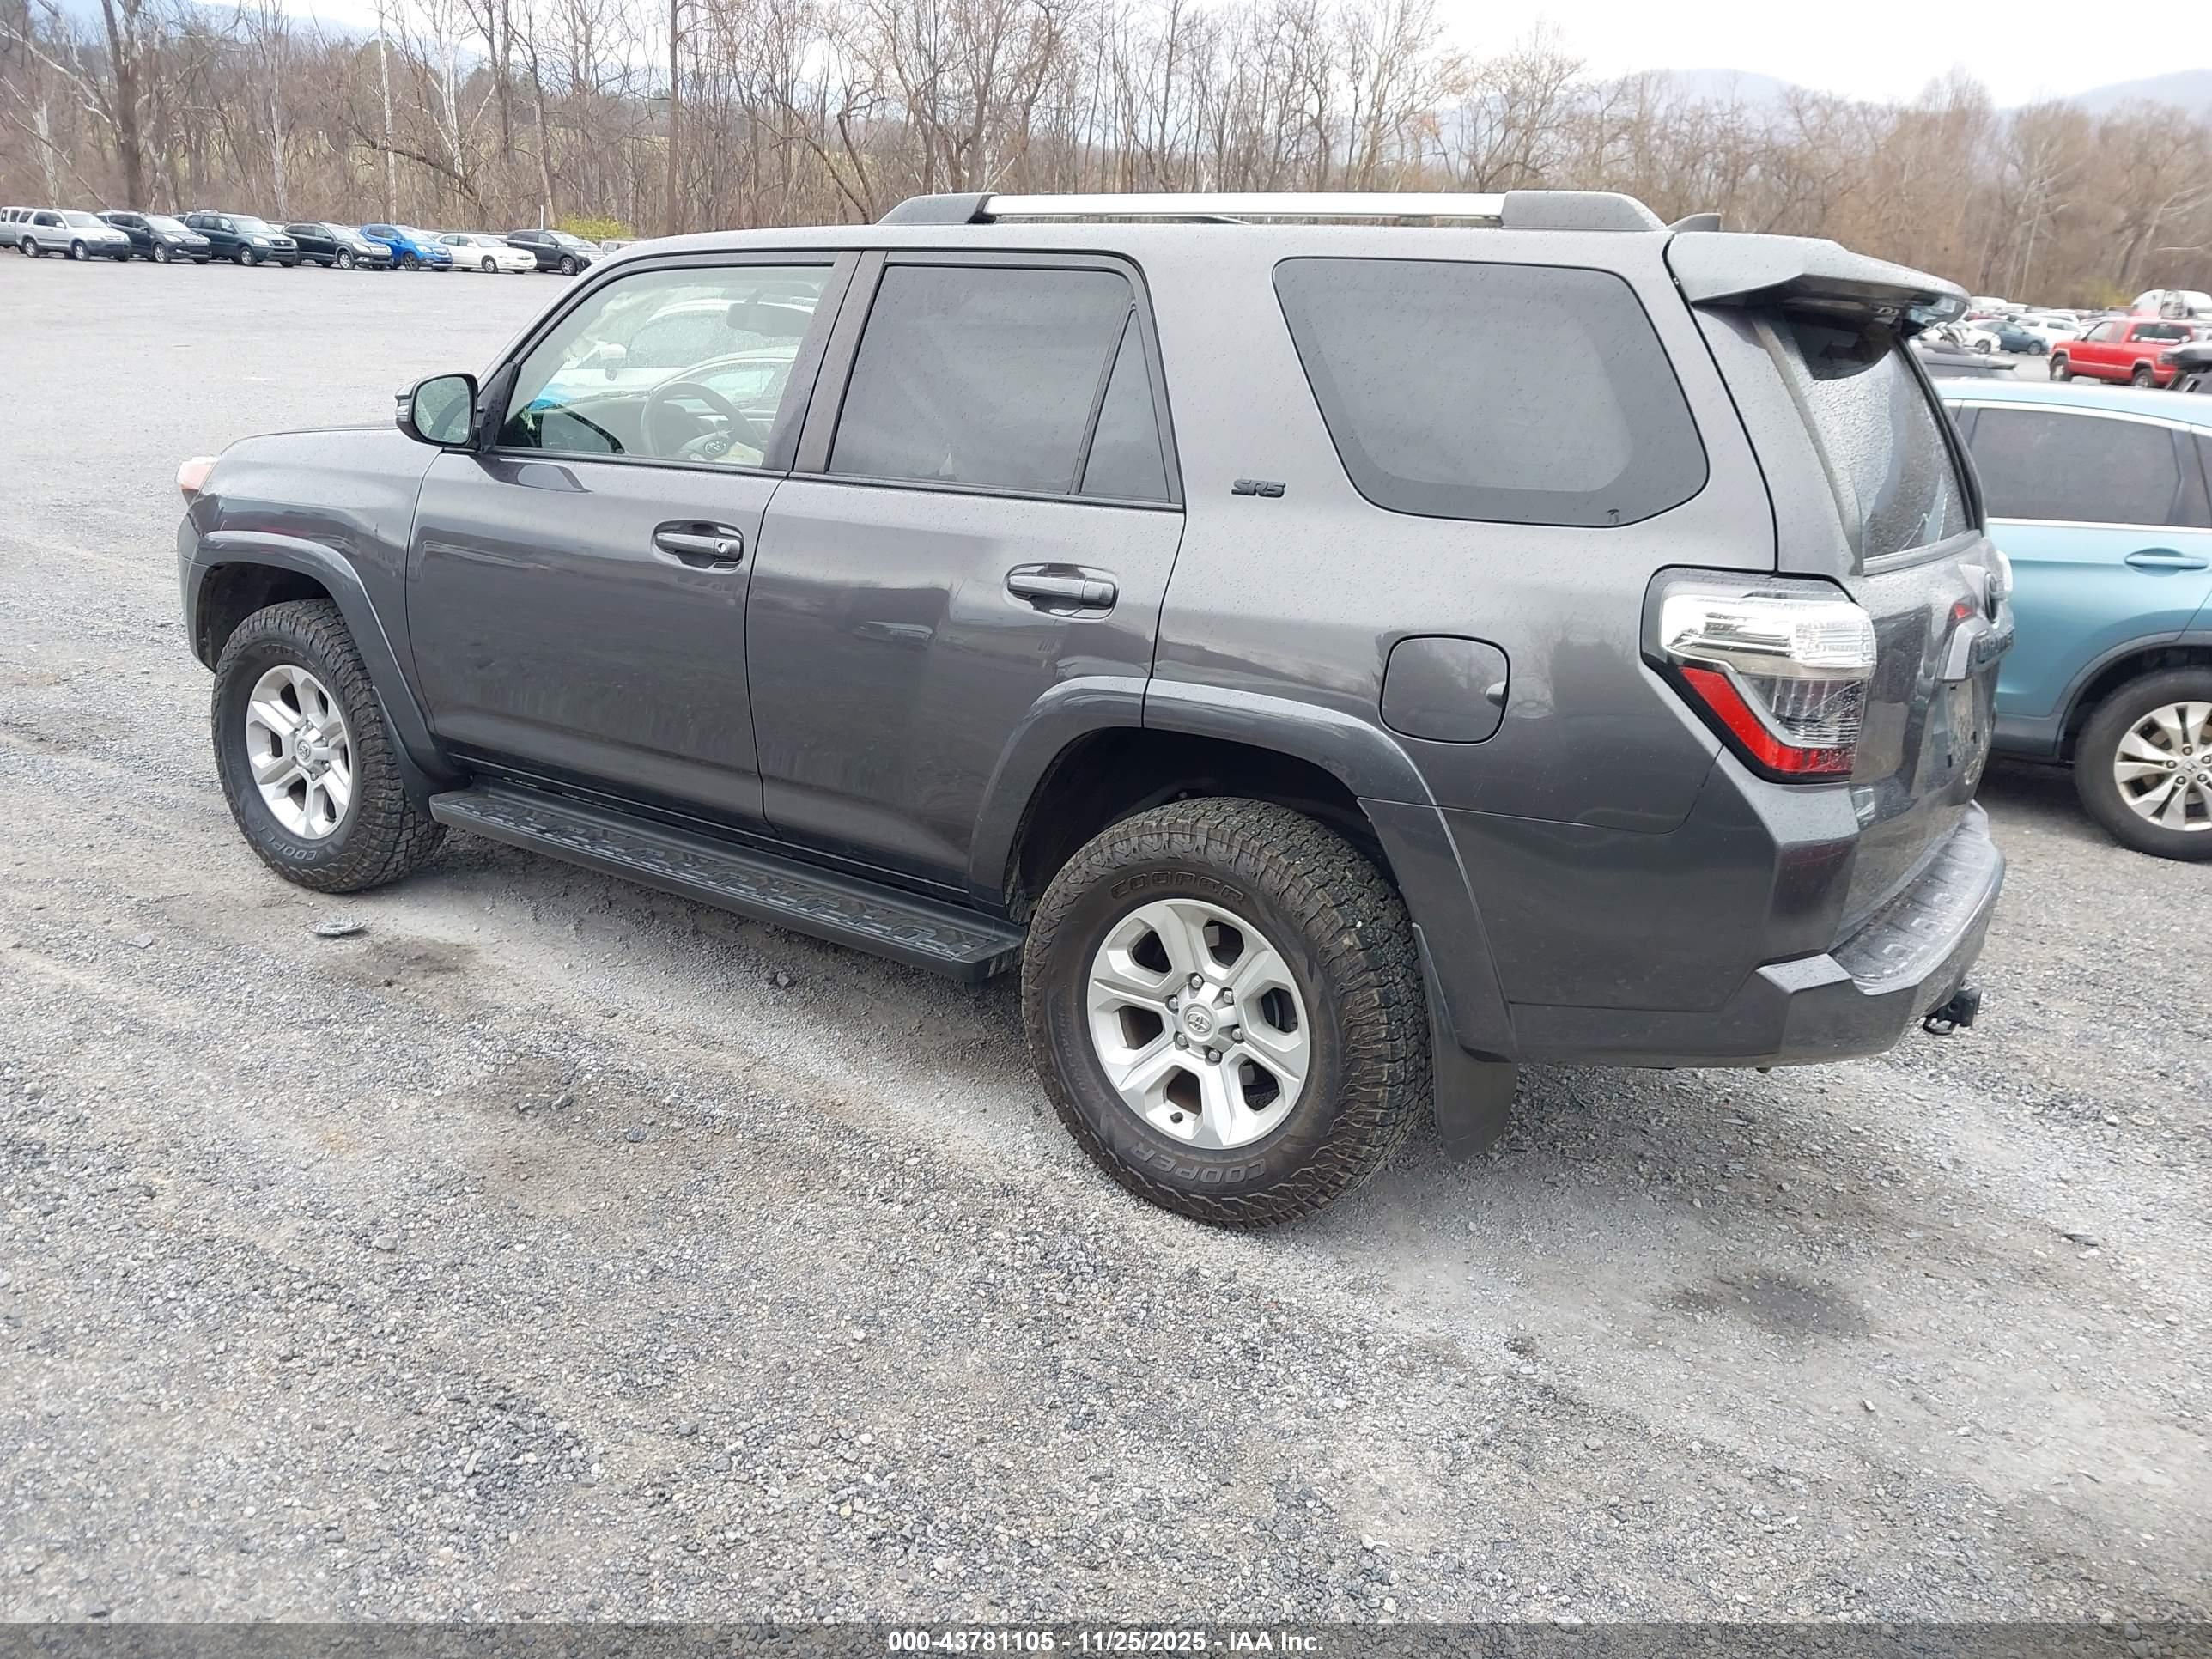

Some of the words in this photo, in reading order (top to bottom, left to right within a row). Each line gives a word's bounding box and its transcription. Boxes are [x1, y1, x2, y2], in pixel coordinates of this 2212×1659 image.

[1231, 479, 1285, 498] SR5
[1110, 871, 1244, 904] COOPER
[1129, 1142, 1267, 1184] COOPER
